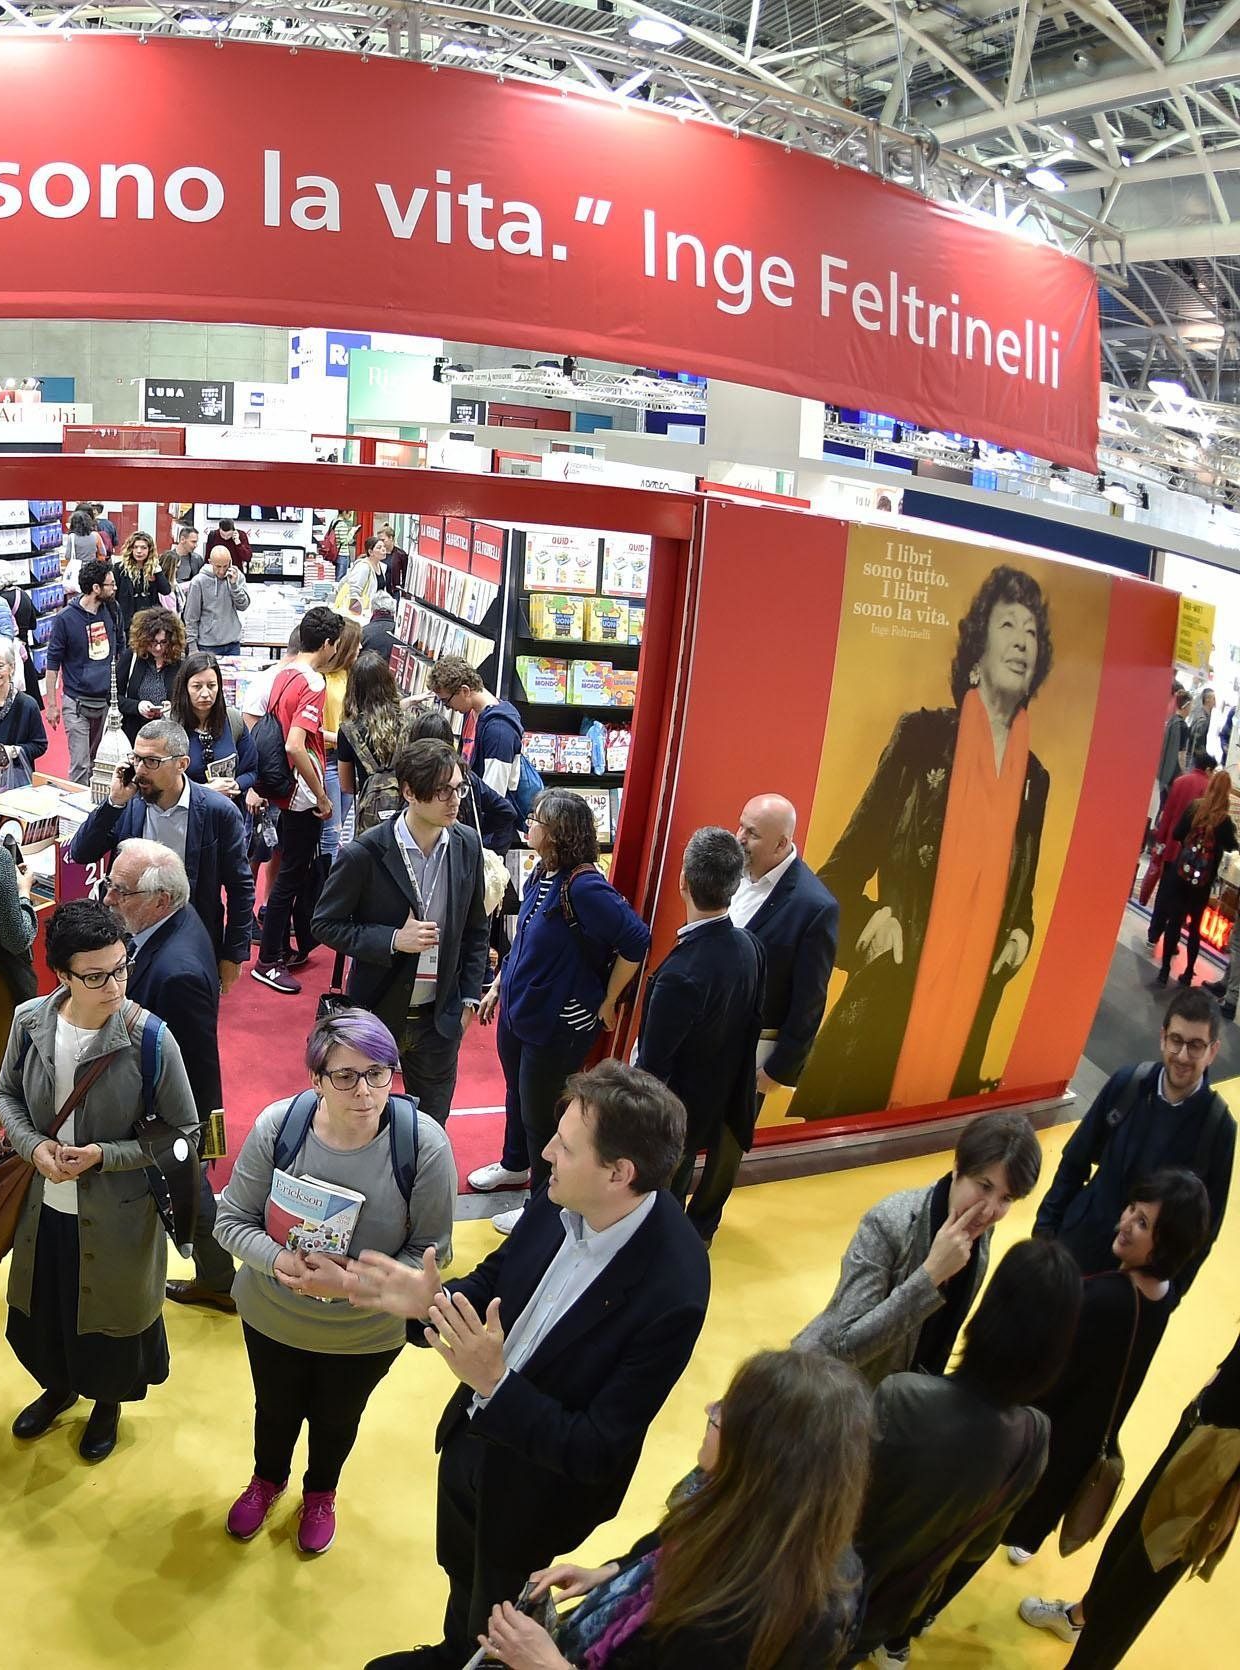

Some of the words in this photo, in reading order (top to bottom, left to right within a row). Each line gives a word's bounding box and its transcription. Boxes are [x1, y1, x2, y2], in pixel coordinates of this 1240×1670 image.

[264, 149, 341, 232] la
[643, 208, 795, 315] Inge
[821, 254, 1059, 389] Feltrinelli
[886, 542, 895, 561] I
[898, 543, 932, 566] libri
[863, 562, 902, 580] sono
[906, 566, 949, 587] tutto.
[881, 580, 890, 598] I
[894, 581, 928, 603] libri
[853, 601, 893, 618] sono
[896, 602, 912, 621] la
[916, 606, 950, 626] vita.
[871, 623, 889, 636] Inge
[891, 624, 931, 640] Feltrinelli
[274, 1178, 324, 1208] Erickson
